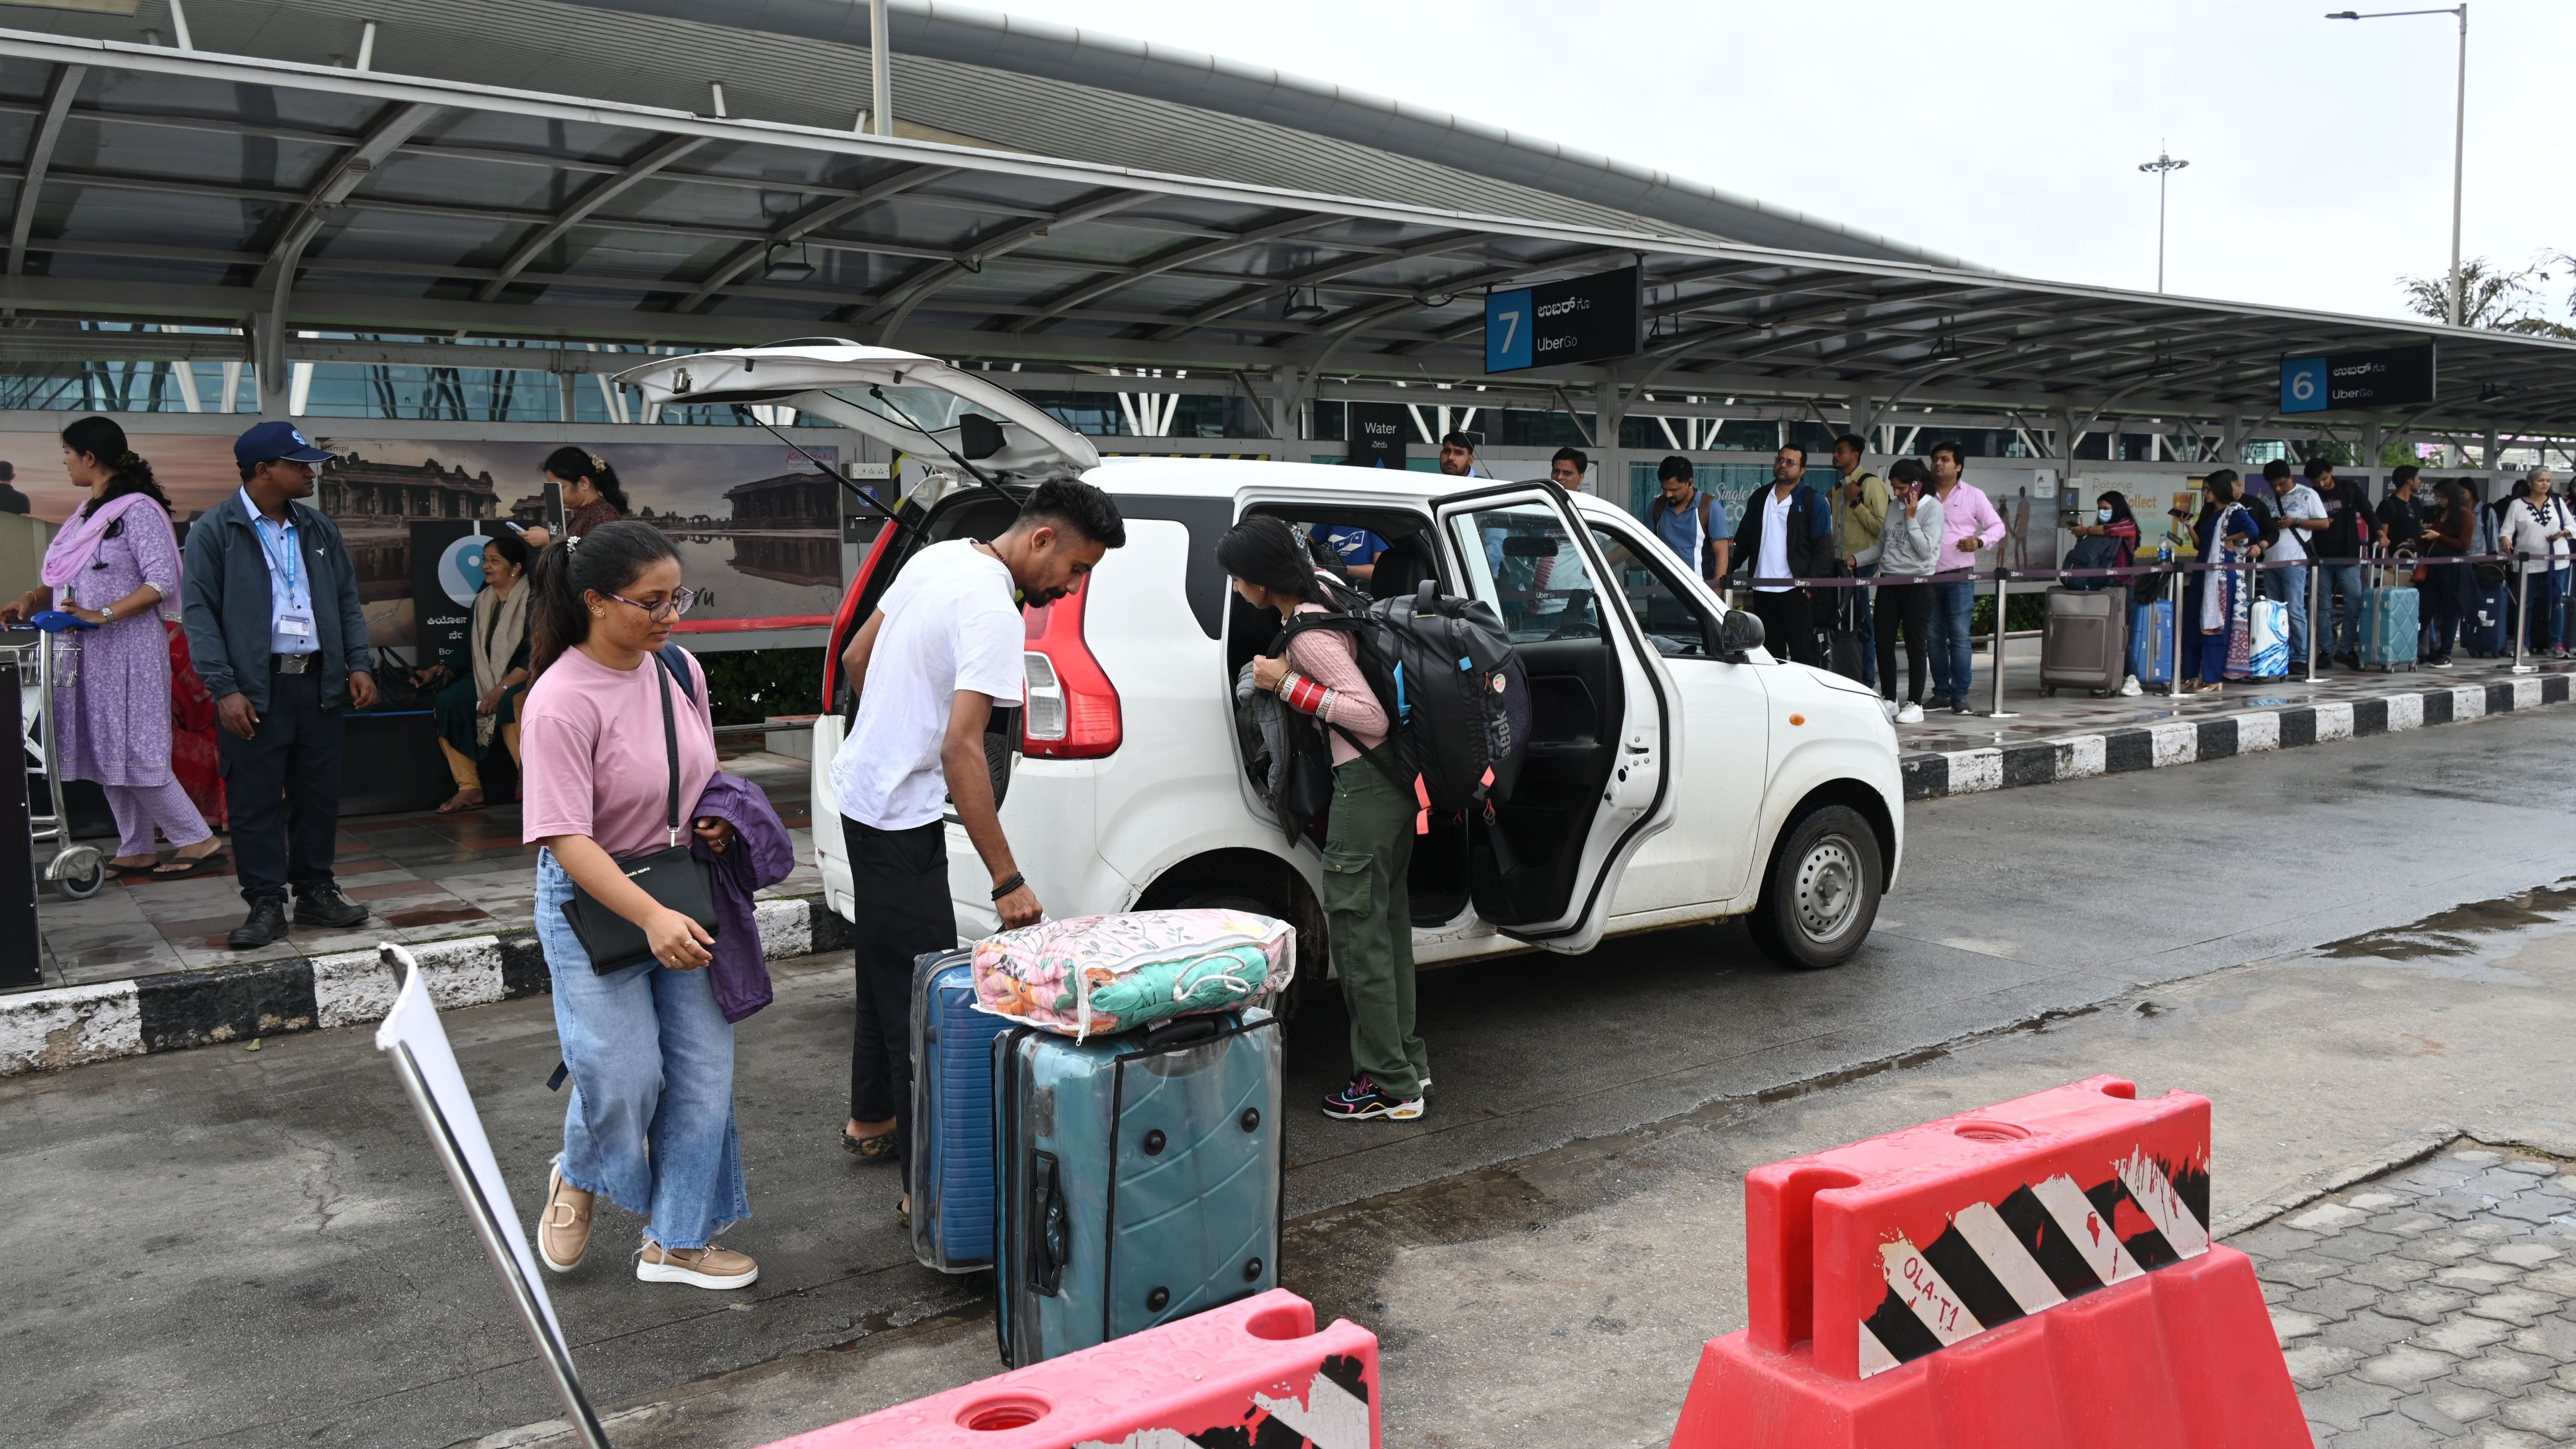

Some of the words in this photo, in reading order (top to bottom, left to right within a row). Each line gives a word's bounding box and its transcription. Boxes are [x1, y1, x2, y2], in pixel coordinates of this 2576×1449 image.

[1537, 296, 1575, 318] ಉಬರ್
[1499, 311, 1519, 354] 7
[2333, 363, 2371, 376] ಉಬರ್
[2293, 372, 2314, 400] 6
[1364, 421, 1397, 434] Water
[1716, 483, 1749, 507] Single
[2093, 478, 2133, 493] Reserve
[2123, 494, 2157, 508] ollect
[1492, 710, 1511, 758] seek
